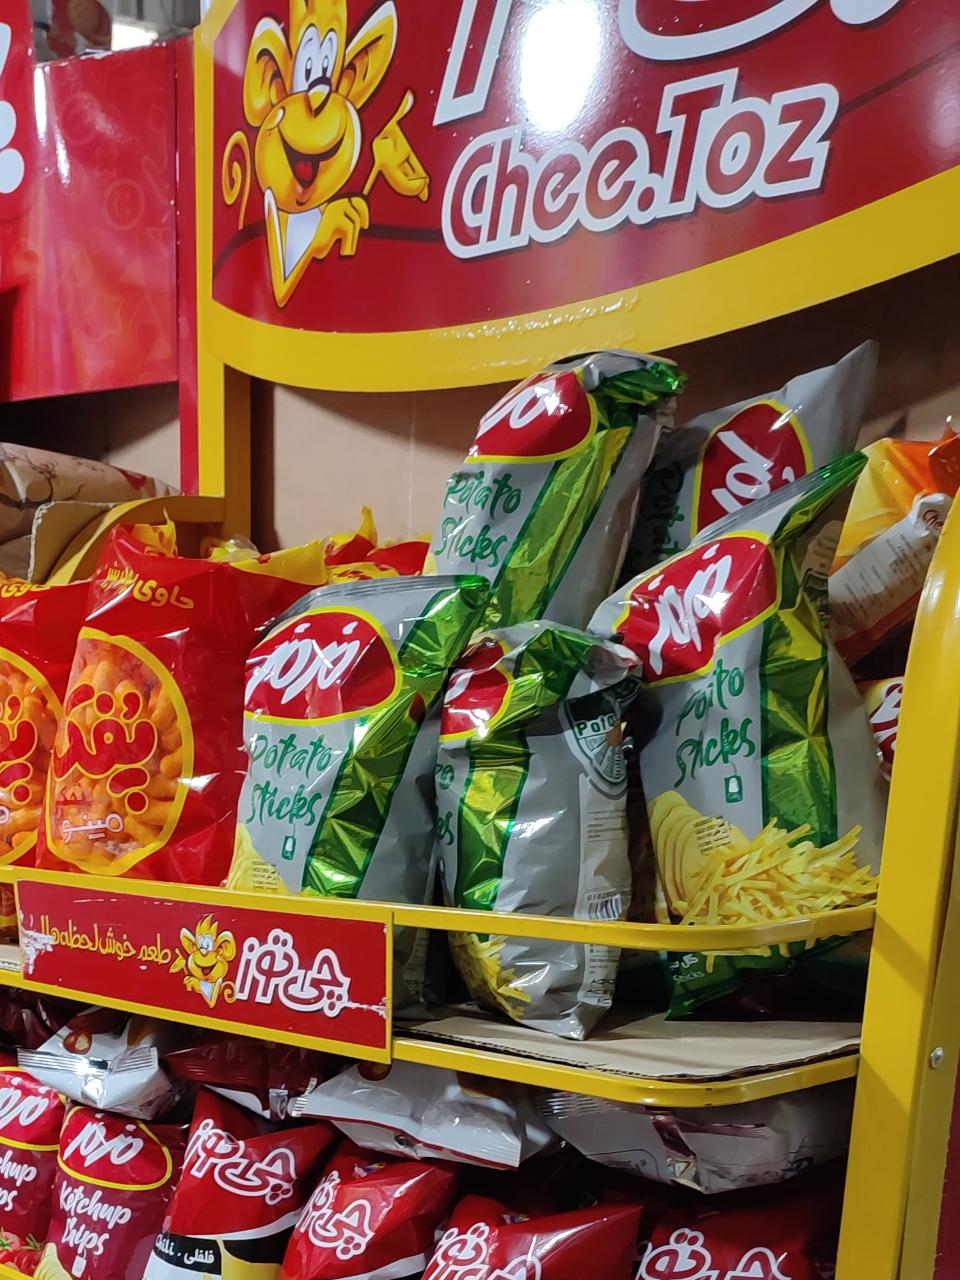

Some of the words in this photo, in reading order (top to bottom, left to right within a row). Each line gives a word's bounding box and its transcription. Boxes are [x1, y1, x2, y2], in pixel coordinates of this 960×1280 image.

[441, 68, 840, 259] Chee.Toz
[248, 732, 334, 780] Potato
[246, 780, 322, 827] Sticks
[62, 812, 124, 844] مینو
[100, 926, 137, 962] خوش
[59, 1180, 132, 1230] Ketchup
